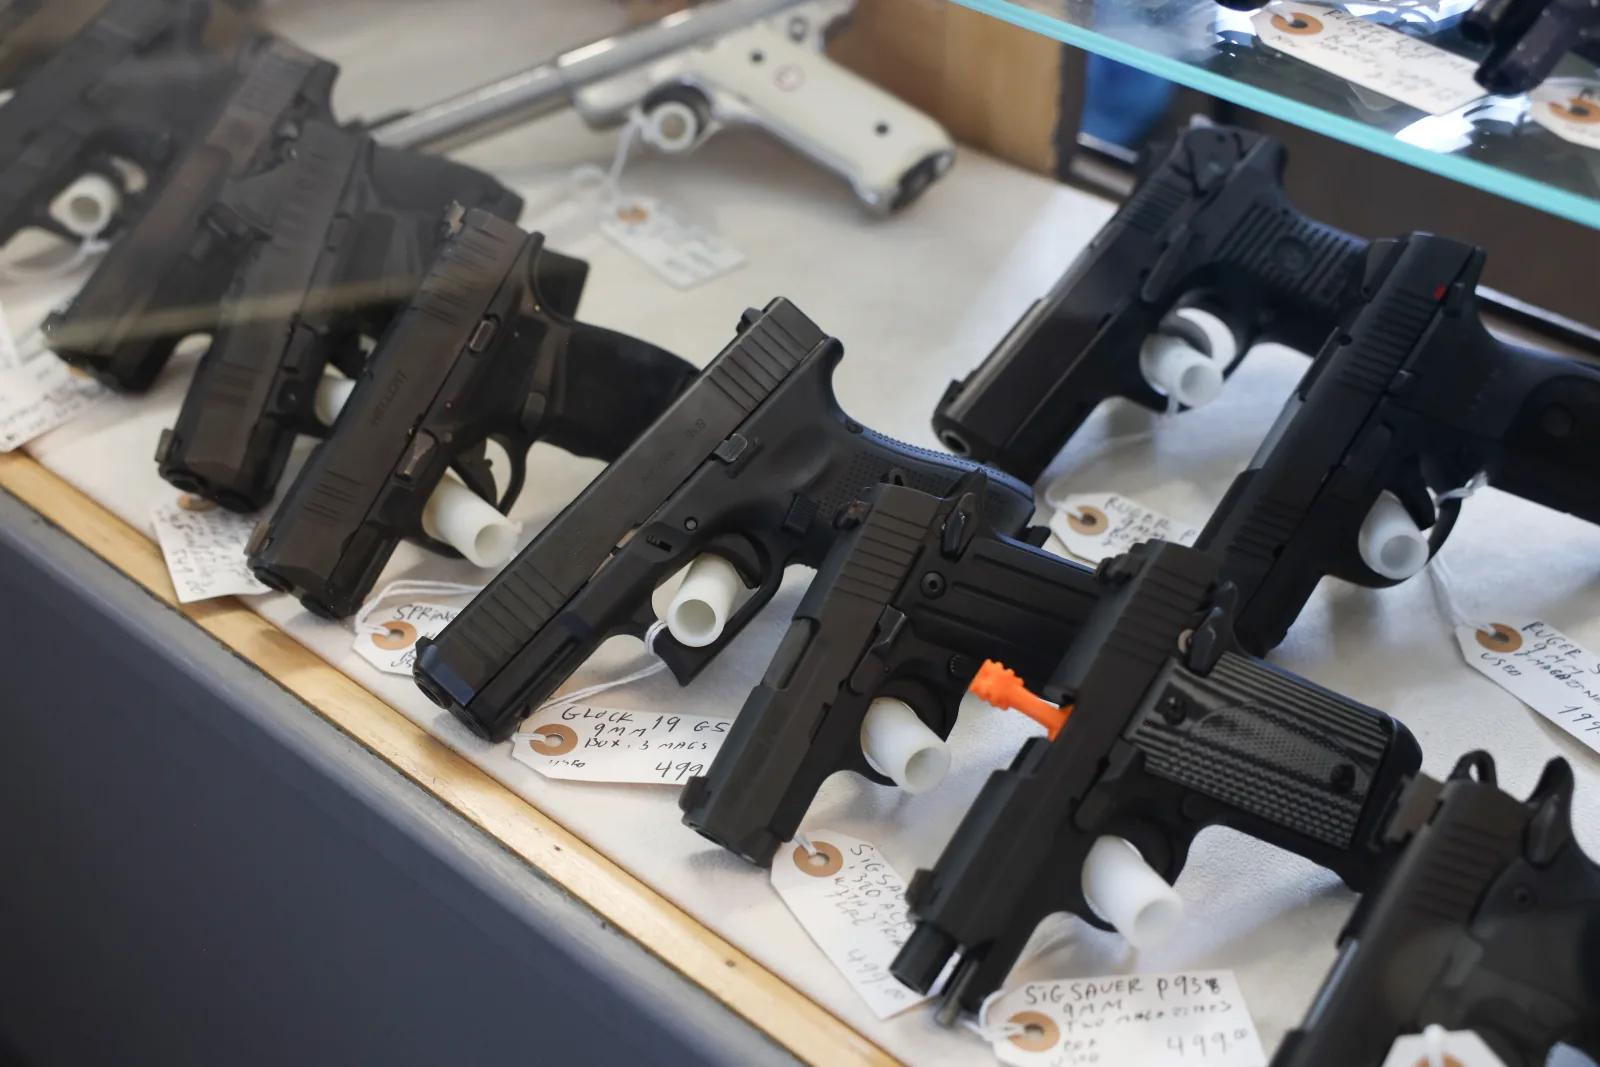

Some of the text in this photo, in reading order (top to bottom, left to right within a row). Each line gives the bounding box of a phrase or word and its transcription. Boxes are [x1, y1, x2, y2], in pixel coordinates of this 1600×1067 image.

[562, 705, 634, 723] GLOCK
[652, 715, 681, 732] 19
[1070, 978, 1144, 1000] SAUER
